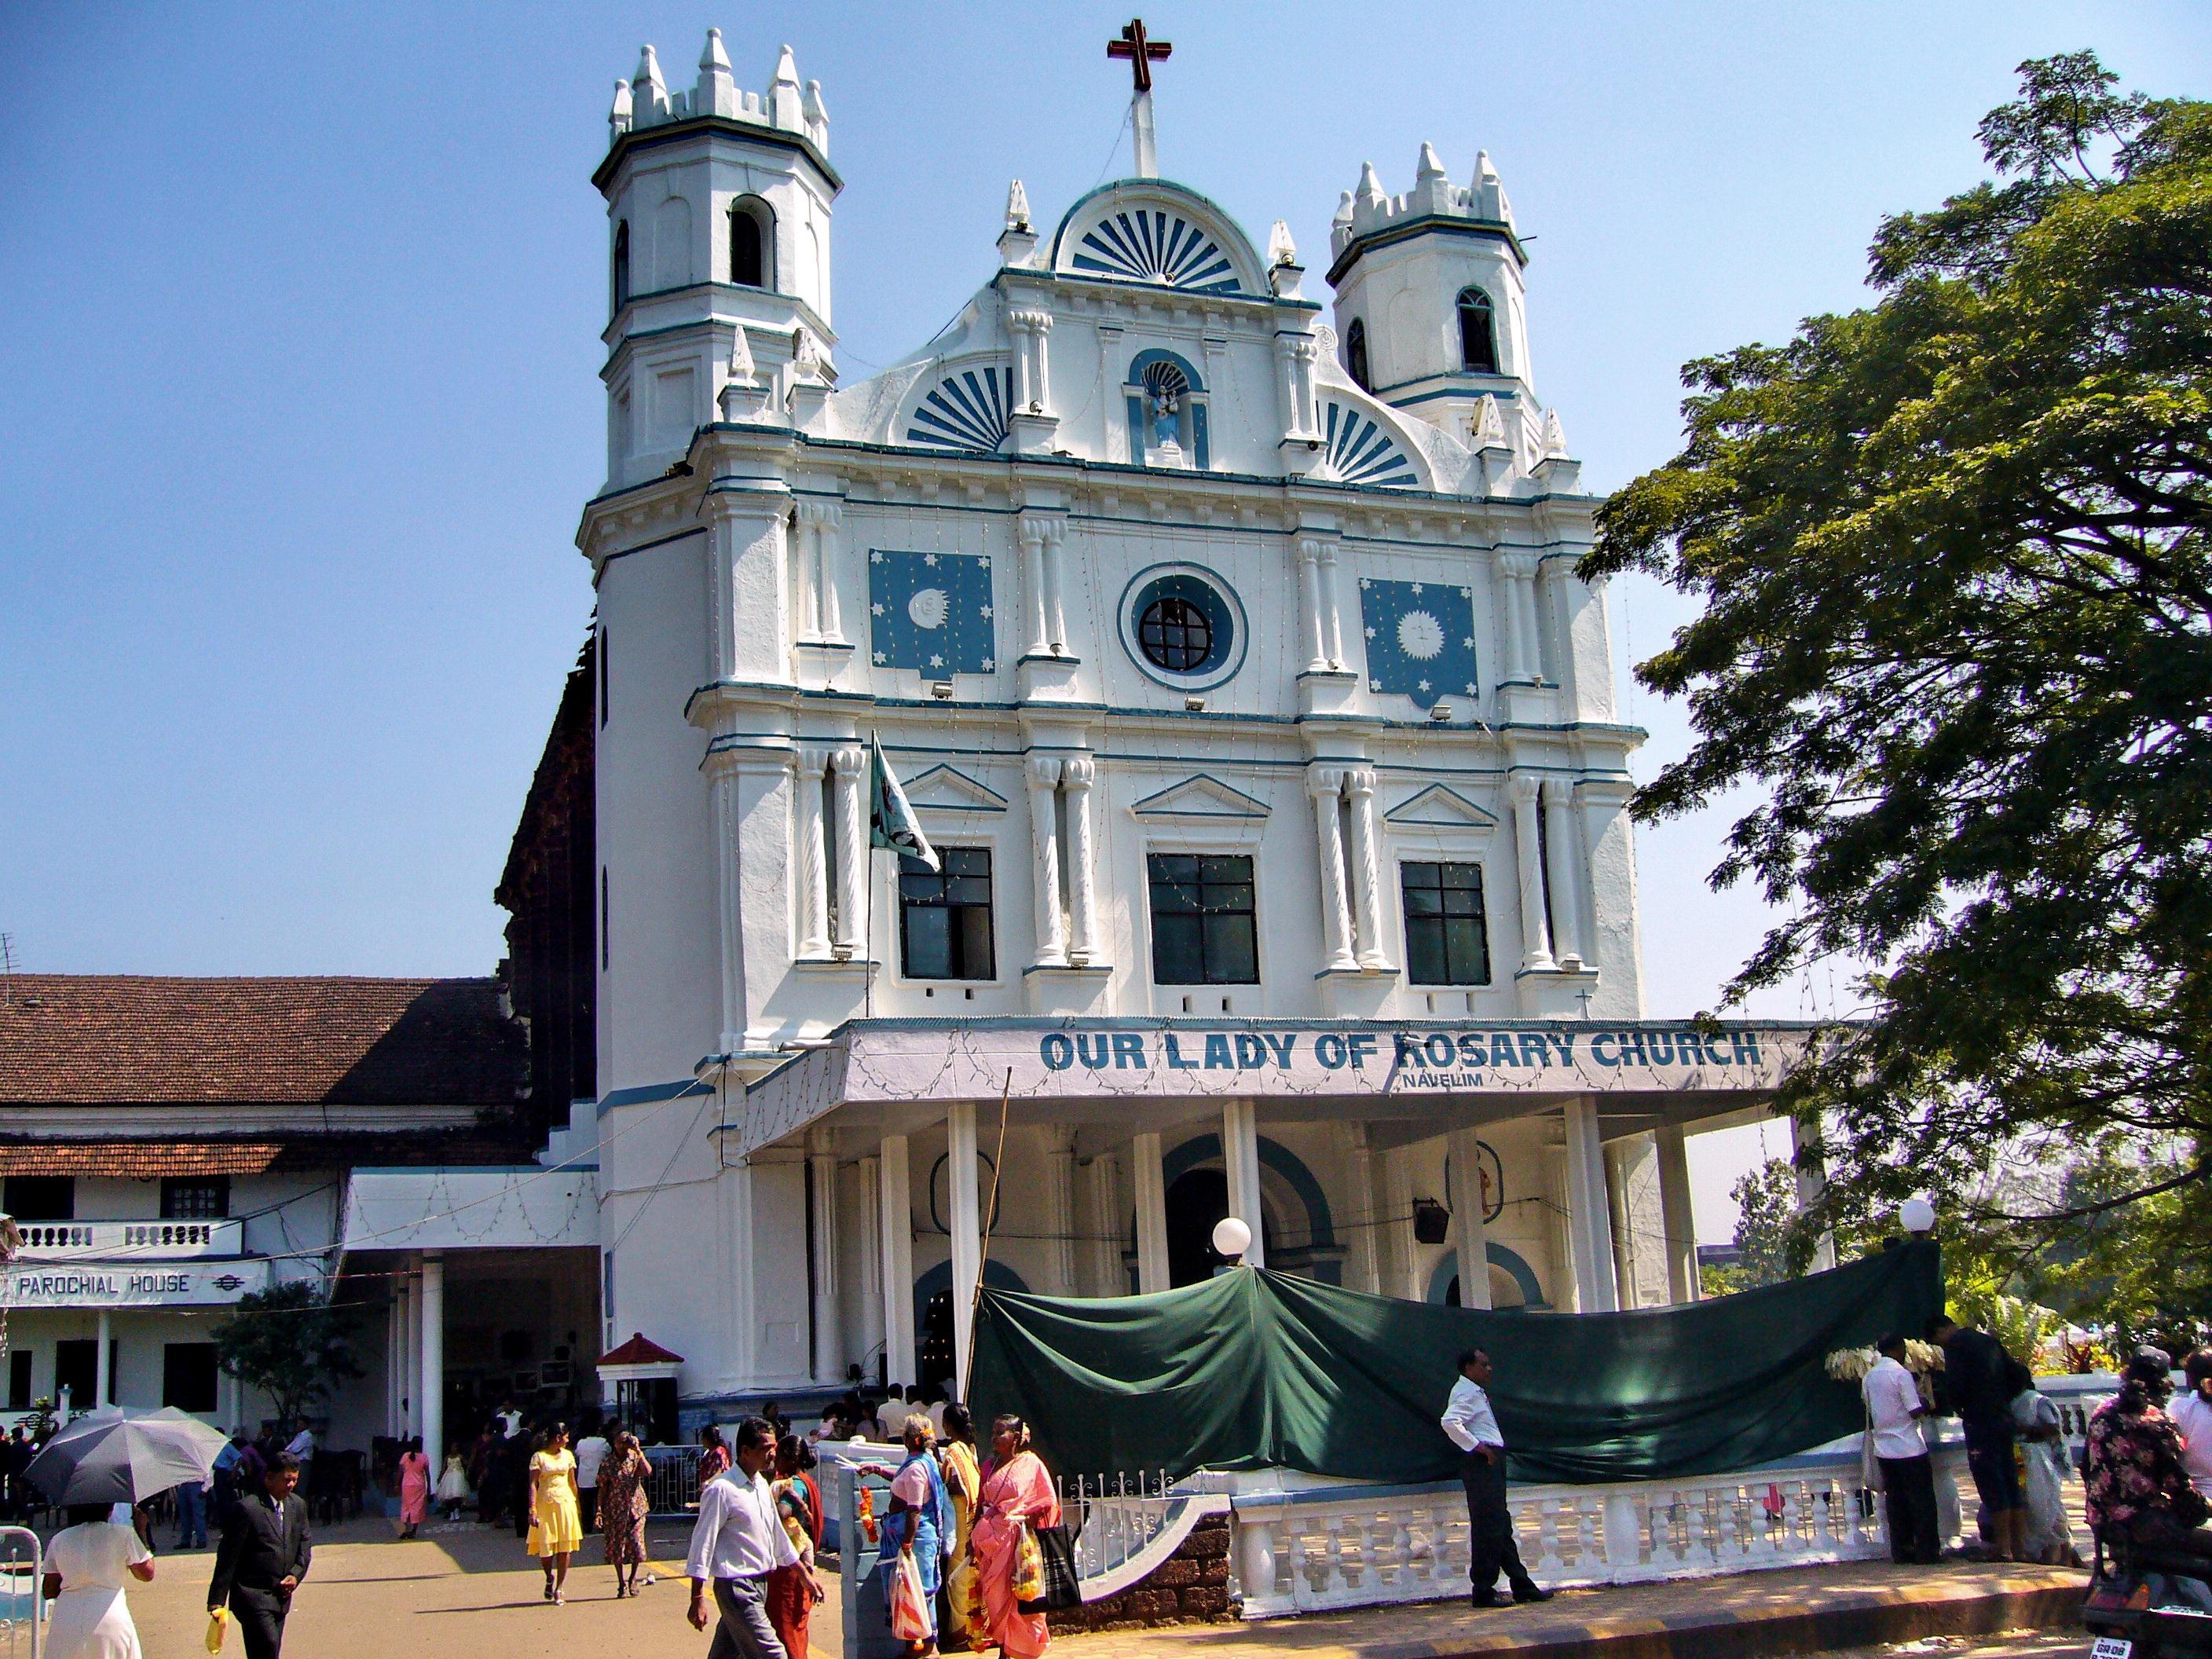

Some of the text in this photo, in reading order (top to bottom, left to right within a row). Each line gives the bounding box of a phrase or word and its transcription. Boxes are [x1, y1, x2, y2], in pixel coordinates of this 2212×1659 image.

[1040, 1032, 1763, 1071] OUR LADY OF ROSARY CHURCH
[1402, 1073, 1484, 1088] NAVELIM
[19, 1274, 190, 1295] PAROCHIAL HOUSE
